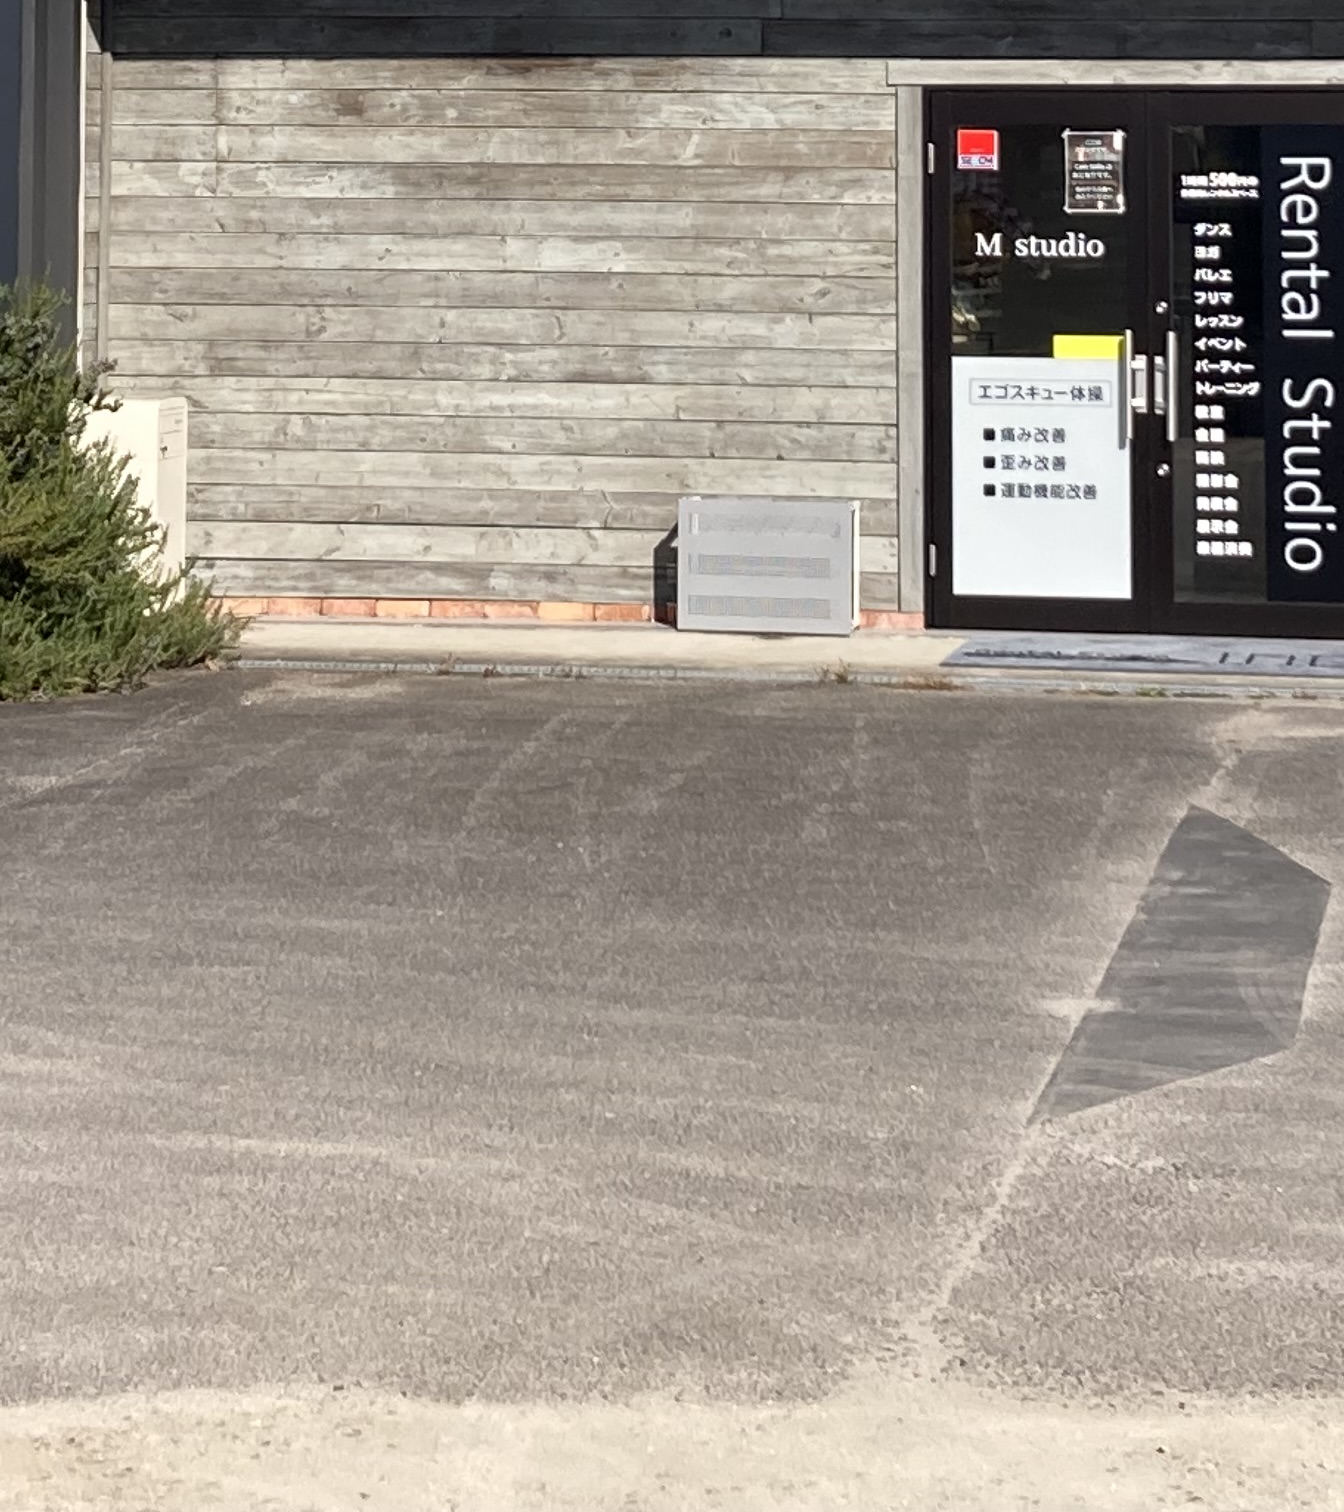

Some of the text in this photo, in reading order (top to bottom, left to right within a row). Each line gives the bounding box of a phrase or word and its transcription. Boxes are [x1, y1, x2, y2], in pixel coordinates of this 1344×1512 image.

[1193, 222, 1233, 237] ダンス
[974, 231, 1105, 257] M studio
[1193, 291, 1234, 305] フリマ
[1194, 314, 1245, 328] レッスン
[1194, 337, 1248, 351] イベント
[1194, 359, 1256, 374] パーティー
[1279, 156, 1337, 572] Rental Studio
[977, 384, 1104, 402] エゴスキュー体操
[1195, 381, 1262, 396] トレーニング
[1000, 427, 1066, 443] 痛み改善
[1000, 482, 1098, 500] 運動機能改善
